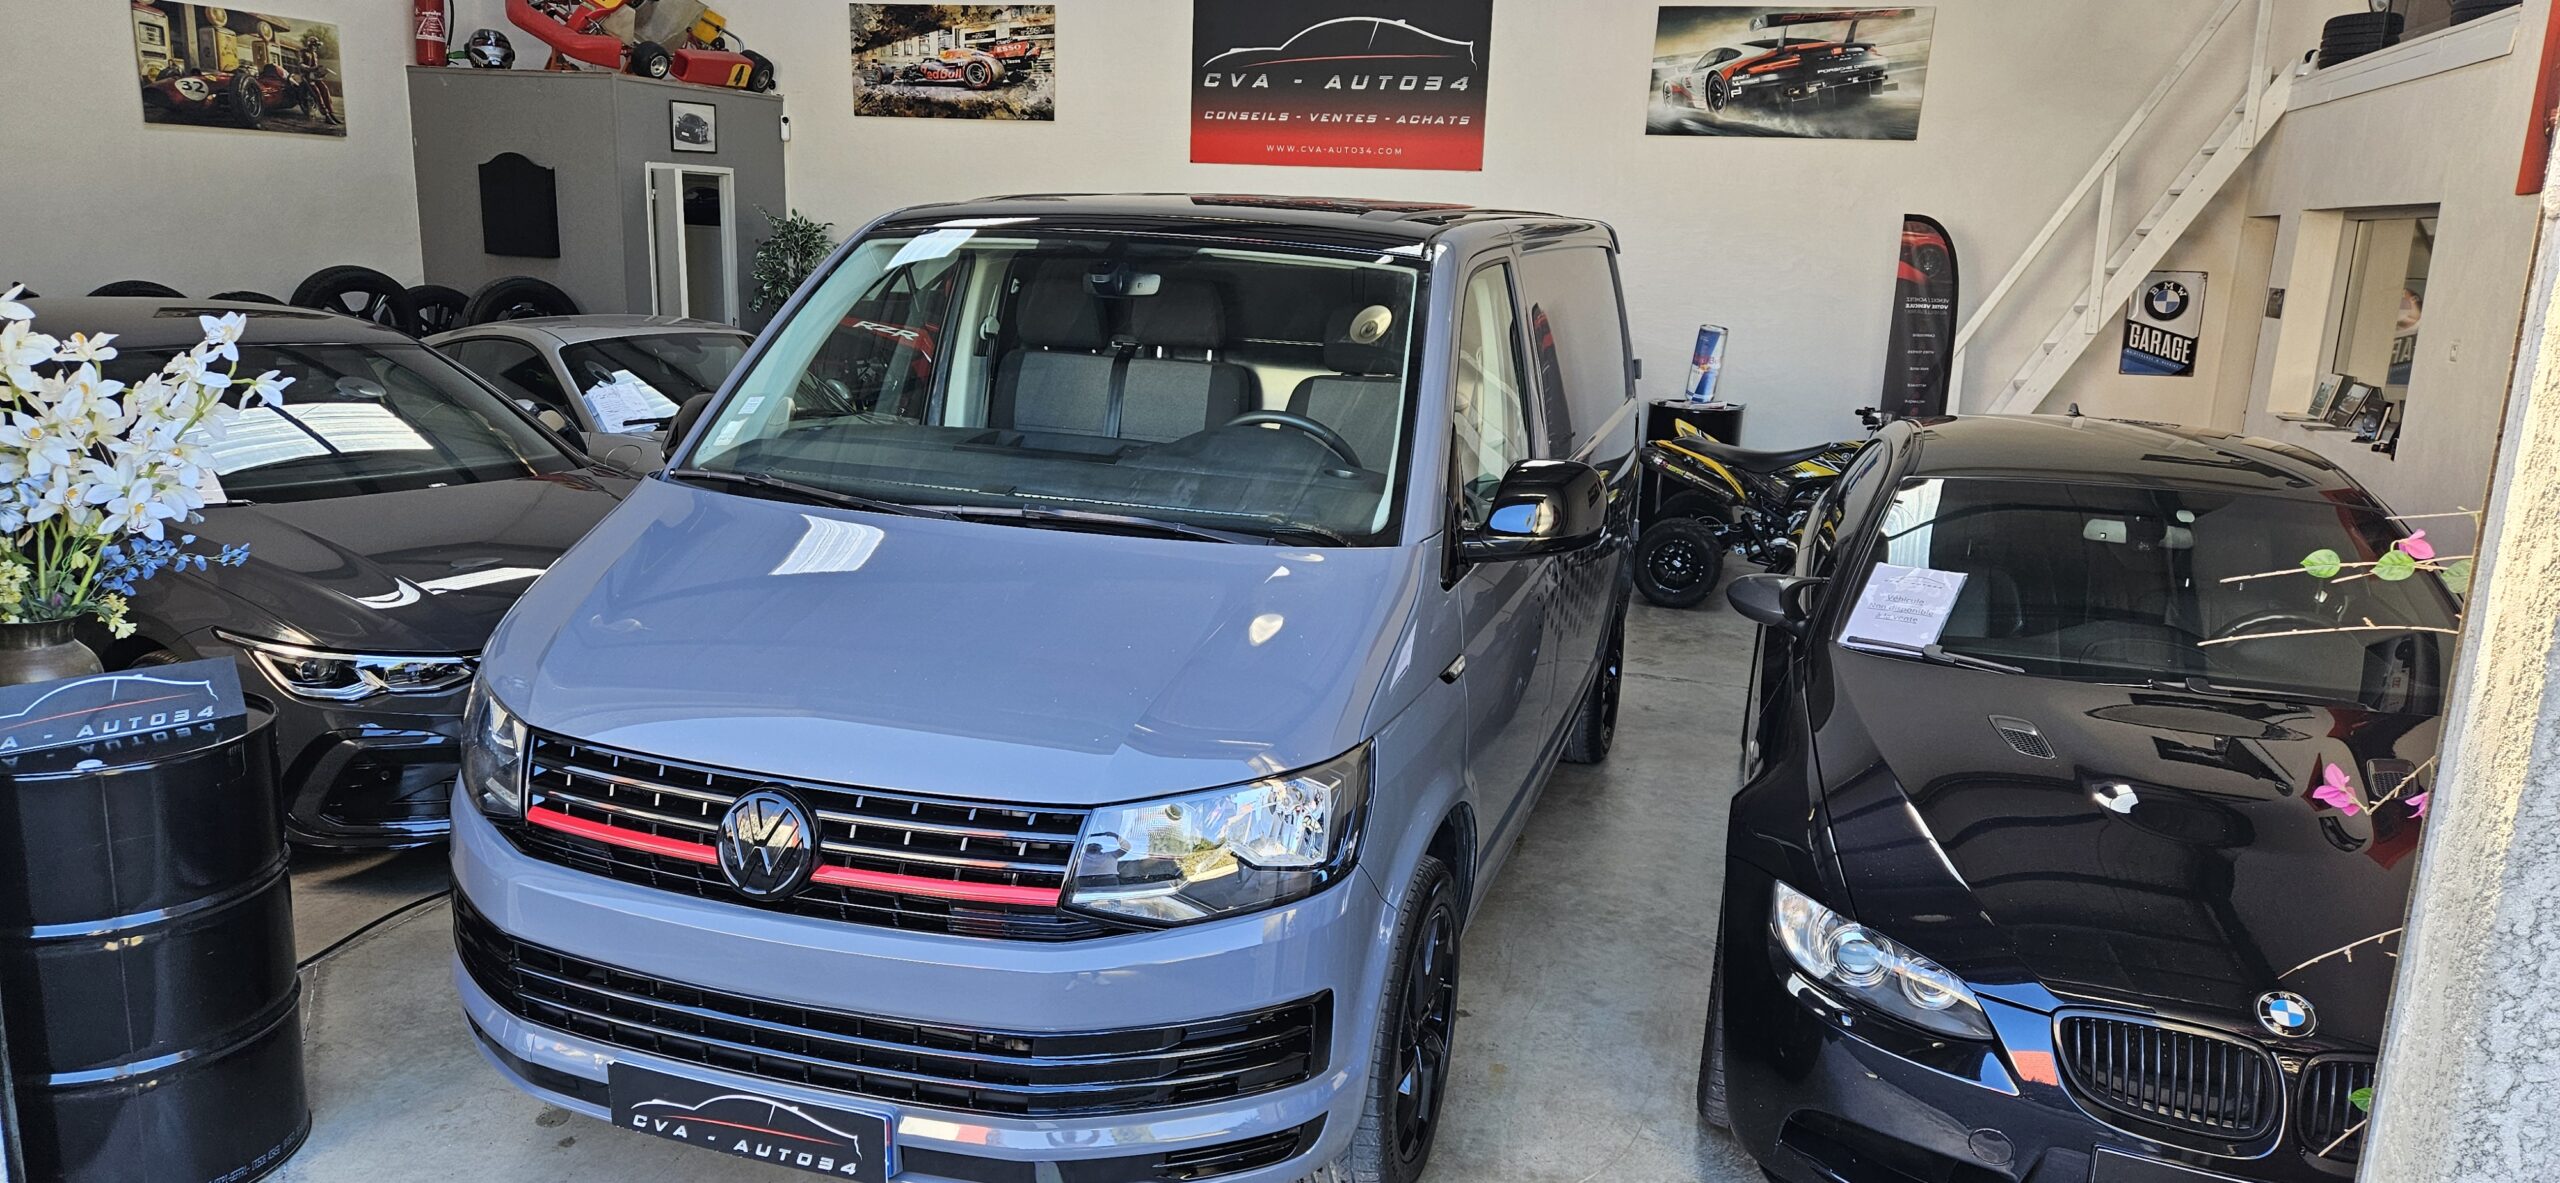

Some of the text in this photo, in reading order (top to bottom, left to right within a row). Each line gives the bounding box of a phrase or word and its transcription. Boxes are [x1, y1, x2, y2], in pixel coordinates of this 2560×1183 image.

[997, 44, 1022, 53] ESSO
[735, 64, 746, 85] 4
[1203, 73, 1270, 89] CVA
[1324, 74, 1470, 91] AUTO34
[180, 80, 206, 94] 32
[1204, 110, 1290, 122] CONSEILS
[1309, 113, 1378, 124] VENTES
[1396, 114, 1470, 125] ACHATS
[1266, 144, 1402, 155] WWW.CVA-AUTO34.COM
[2150, 282, 2187, 297] BMW
[852, 320, 920, 341] RZR
[2129, 324, 2192, 364] GARAGE
[76, 706, 214, 738] AUTO34
[633, 1114, 688, 1139] CVA
[733, 1139, 859, 1176] AUTO34
